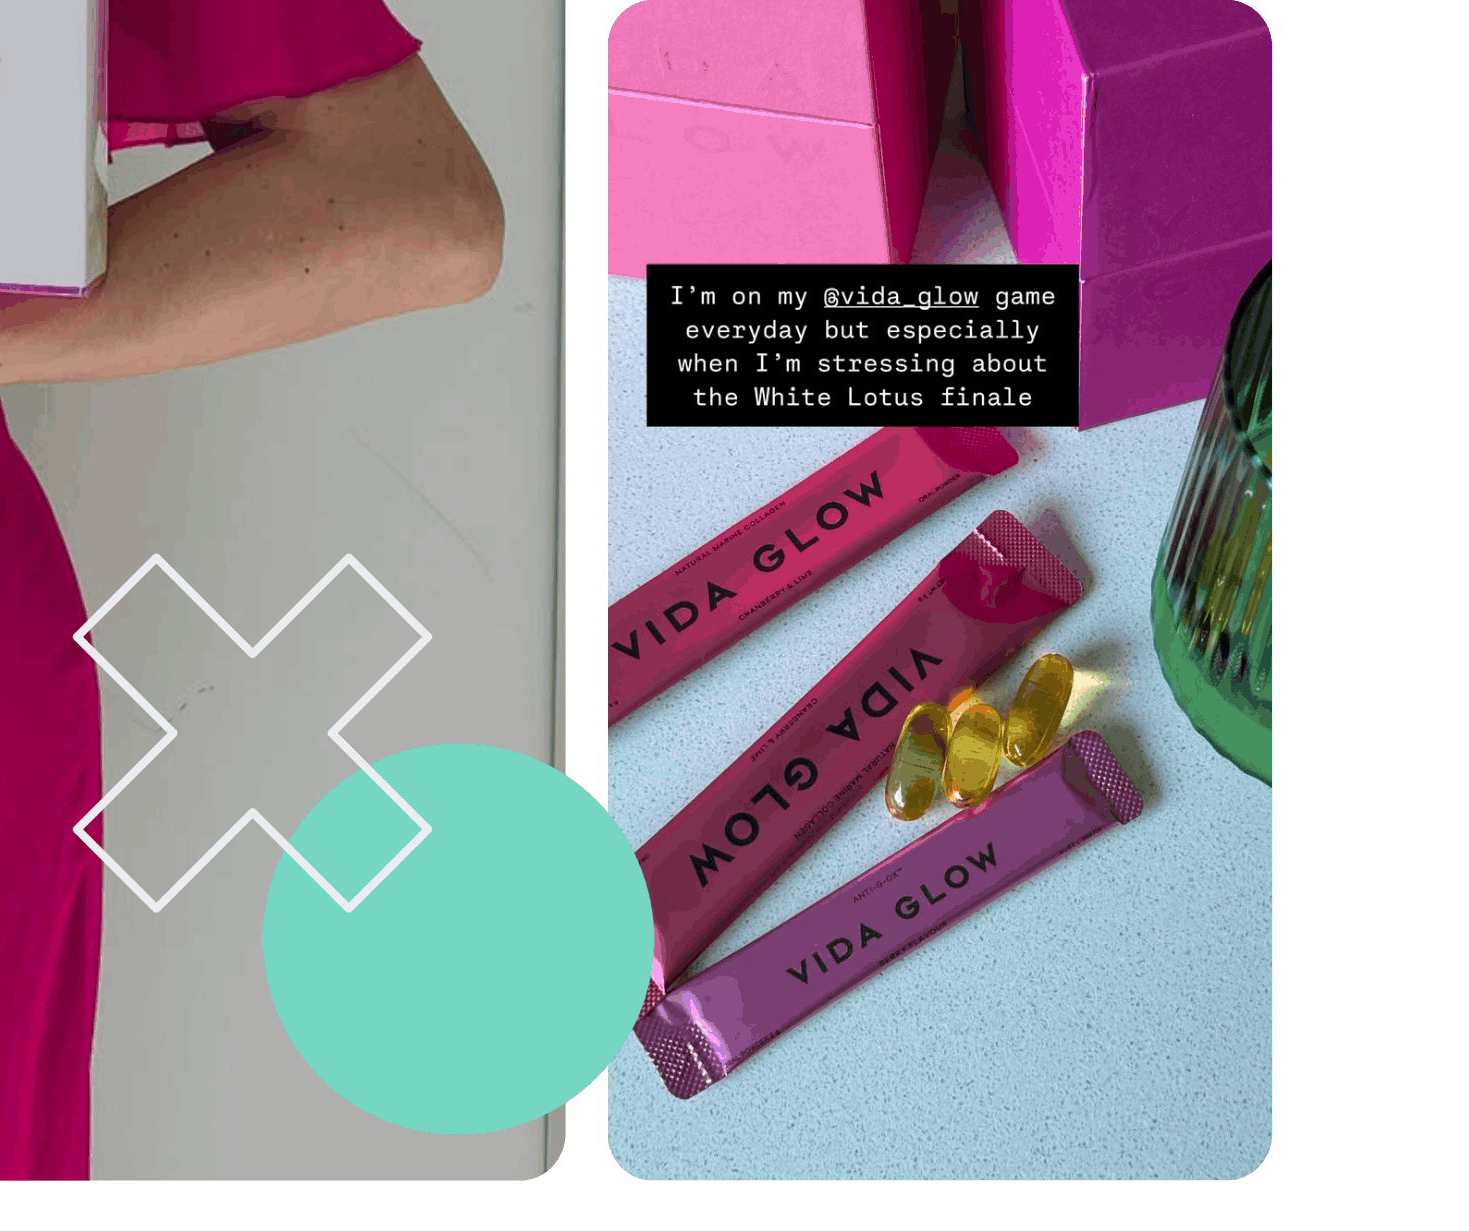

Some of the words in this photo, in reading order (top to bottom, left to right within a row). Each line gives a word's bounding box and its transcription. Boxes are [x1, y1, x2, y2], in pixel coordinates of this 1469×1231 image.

[675, 548, 712, 576] NATURAL
[712, 528, 743, 553] MARINE
[743, 500, 787, 531] COLLAGEN
[610, 581, 738, 660] VIDA
[753, 470, 884, 573] GLOW
[738, 586, 785, 621] CRANBERRY
[793, 569, 814, 586] LIME
[775, 697, 818, 739] CRANBERRY
[825, 648, 943, 742] VIDA
[750, 741, 769, 762] LIME
[862, 742, 896, 773] NATURAL
[832, 774, 863, 803] MARINE
[689, 757, 818, 887] GLOW
[794, 800, 834, 839] COLLAGEN
[786, 922, 883, 985] VIDA
[895, 842, 997, 920] GLOW
[879, 945, 907, 966] BERRY
[906, 920, 948, 949] FLAVOUR
